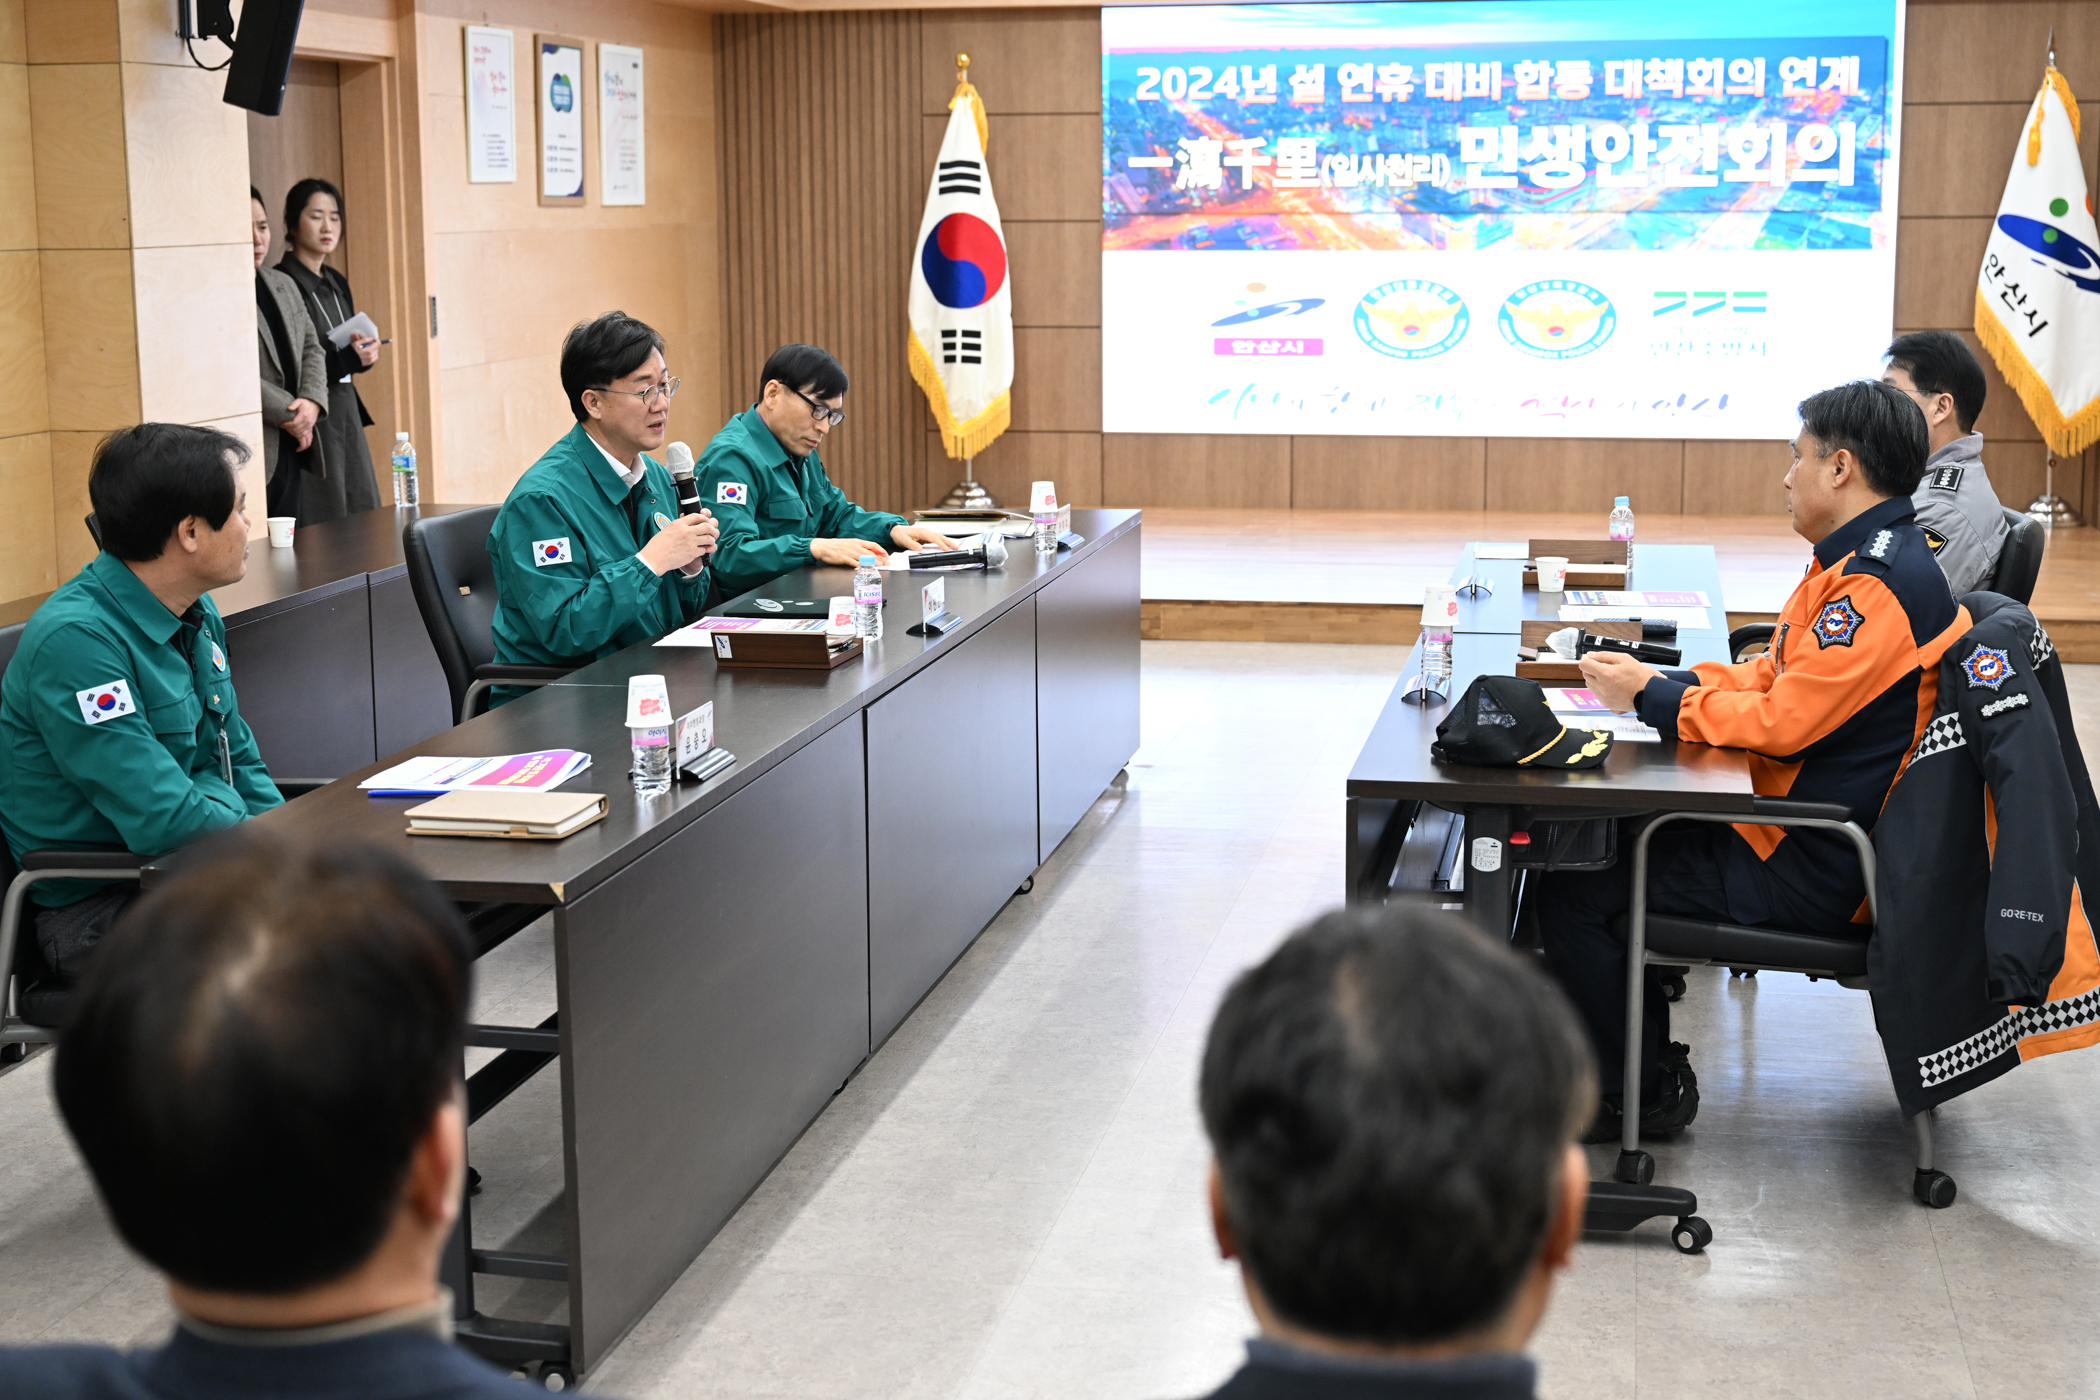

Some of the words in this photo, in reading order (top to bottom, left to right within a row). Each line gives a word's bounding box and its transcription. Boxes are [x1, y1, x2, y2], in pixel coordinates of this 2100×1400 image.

[1135, 64, 1277, 103] 2024년
[1287, 63, 1326, 103] 설
[1337, 62, 1415, 102] 연휴
[1425, 62, 1501, 101] 대비
[1603, 57, 1766, 98] 대책회의
[1778, 55, 1861, 97] 연계
[1460, 122, 1857, 189] 민생안전회의
[1985, 254, 2048, 337] 안산시
[1231, 339, 1304, 354] 안산시
[2000, 908, 2044, 923] GORE-TEX
